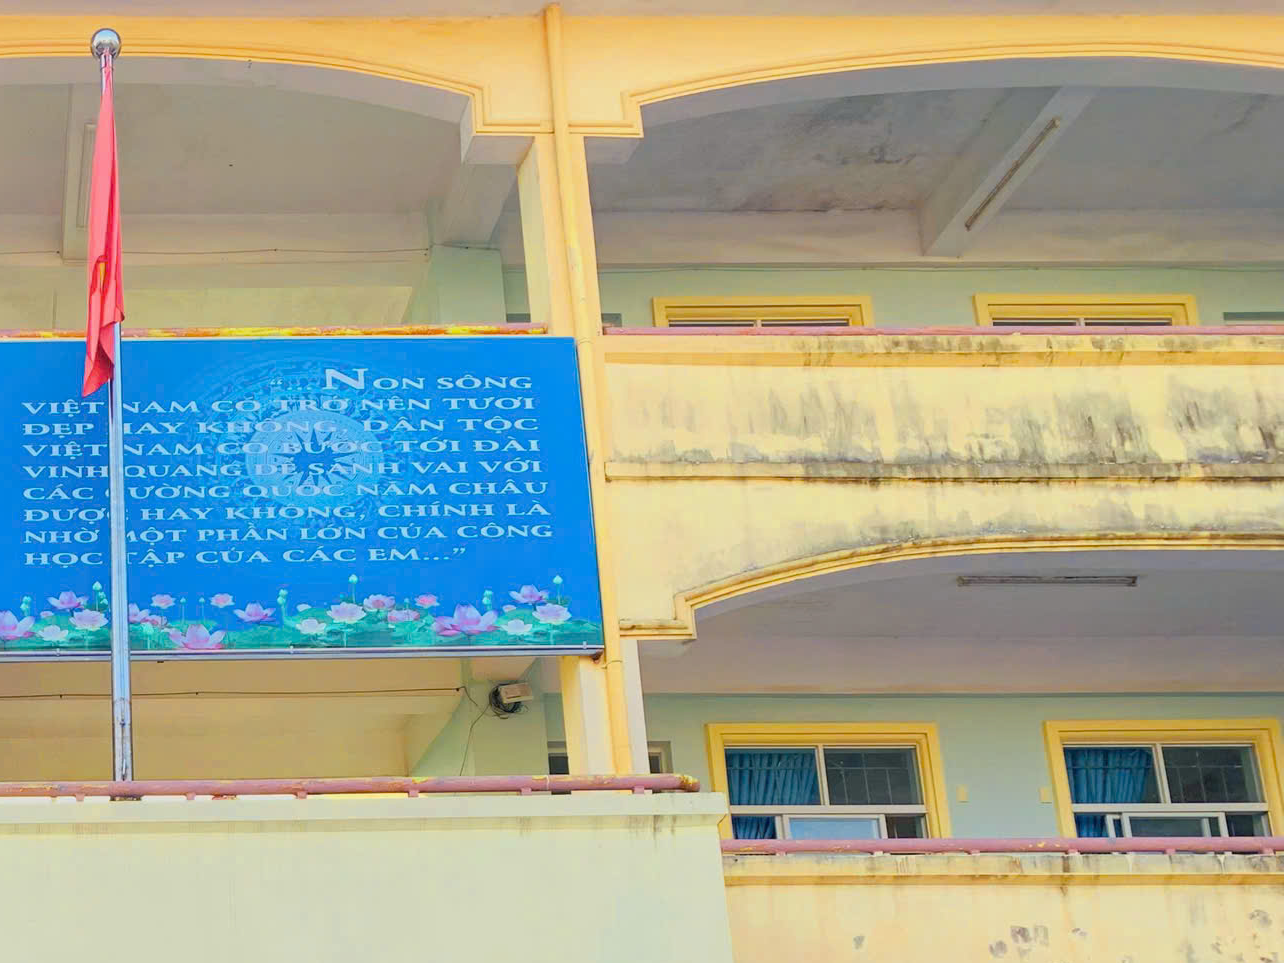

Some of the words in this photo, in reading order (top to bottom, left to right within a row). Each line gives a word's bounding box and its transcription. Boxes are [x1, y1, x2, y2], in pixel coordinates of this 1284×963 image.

[437, 374, 532, 390] SÔNG
[22, 398, 104, 418] VIỆT
[361, 395, 430, 411] NÊN
[442, 397, 535, 411] TƯƠI
[22, 423, 94, 439] ĐẸP
[364, 416, 445, 432] DÂN
[458, 416, 538, 434] TỘC
[22, 441, 107, 460] VIỆT
[394, 438, 460, 453] TỚI
[473, 434, 540, 453] ĐÀI
[23, 465, 108, 479] VINH
[125, 464, 242, 479] QUANG
[412, 461, 468, 474] VAI
[479, 458, 543, 473] VỚI
[23, 483, 94, 500] CÁC
[106, 483, 229, 499] ƯỜNG
[357, 480, 438, 496] NĂM
[449, 479, 548, 495] CHÂU
[24, 508, 128, 524] ĐƯỢ
[141, 507, 214, 520] HAY
[226, 504, 366, 521] KHÔNG,
[378, 500, 495, 517] CHÍNH
[506, 500, 552, 516] LÀ
[24, 528, 100, 544] NHỜ
[197, 521, 288, 542] PHẦN
[300, 523, 366, 541] LỚN
[456, 522, 553, 538] CÔNG
[24, 552, 103, 569] HỌC
[282, 546, 356, 563] CÁC
